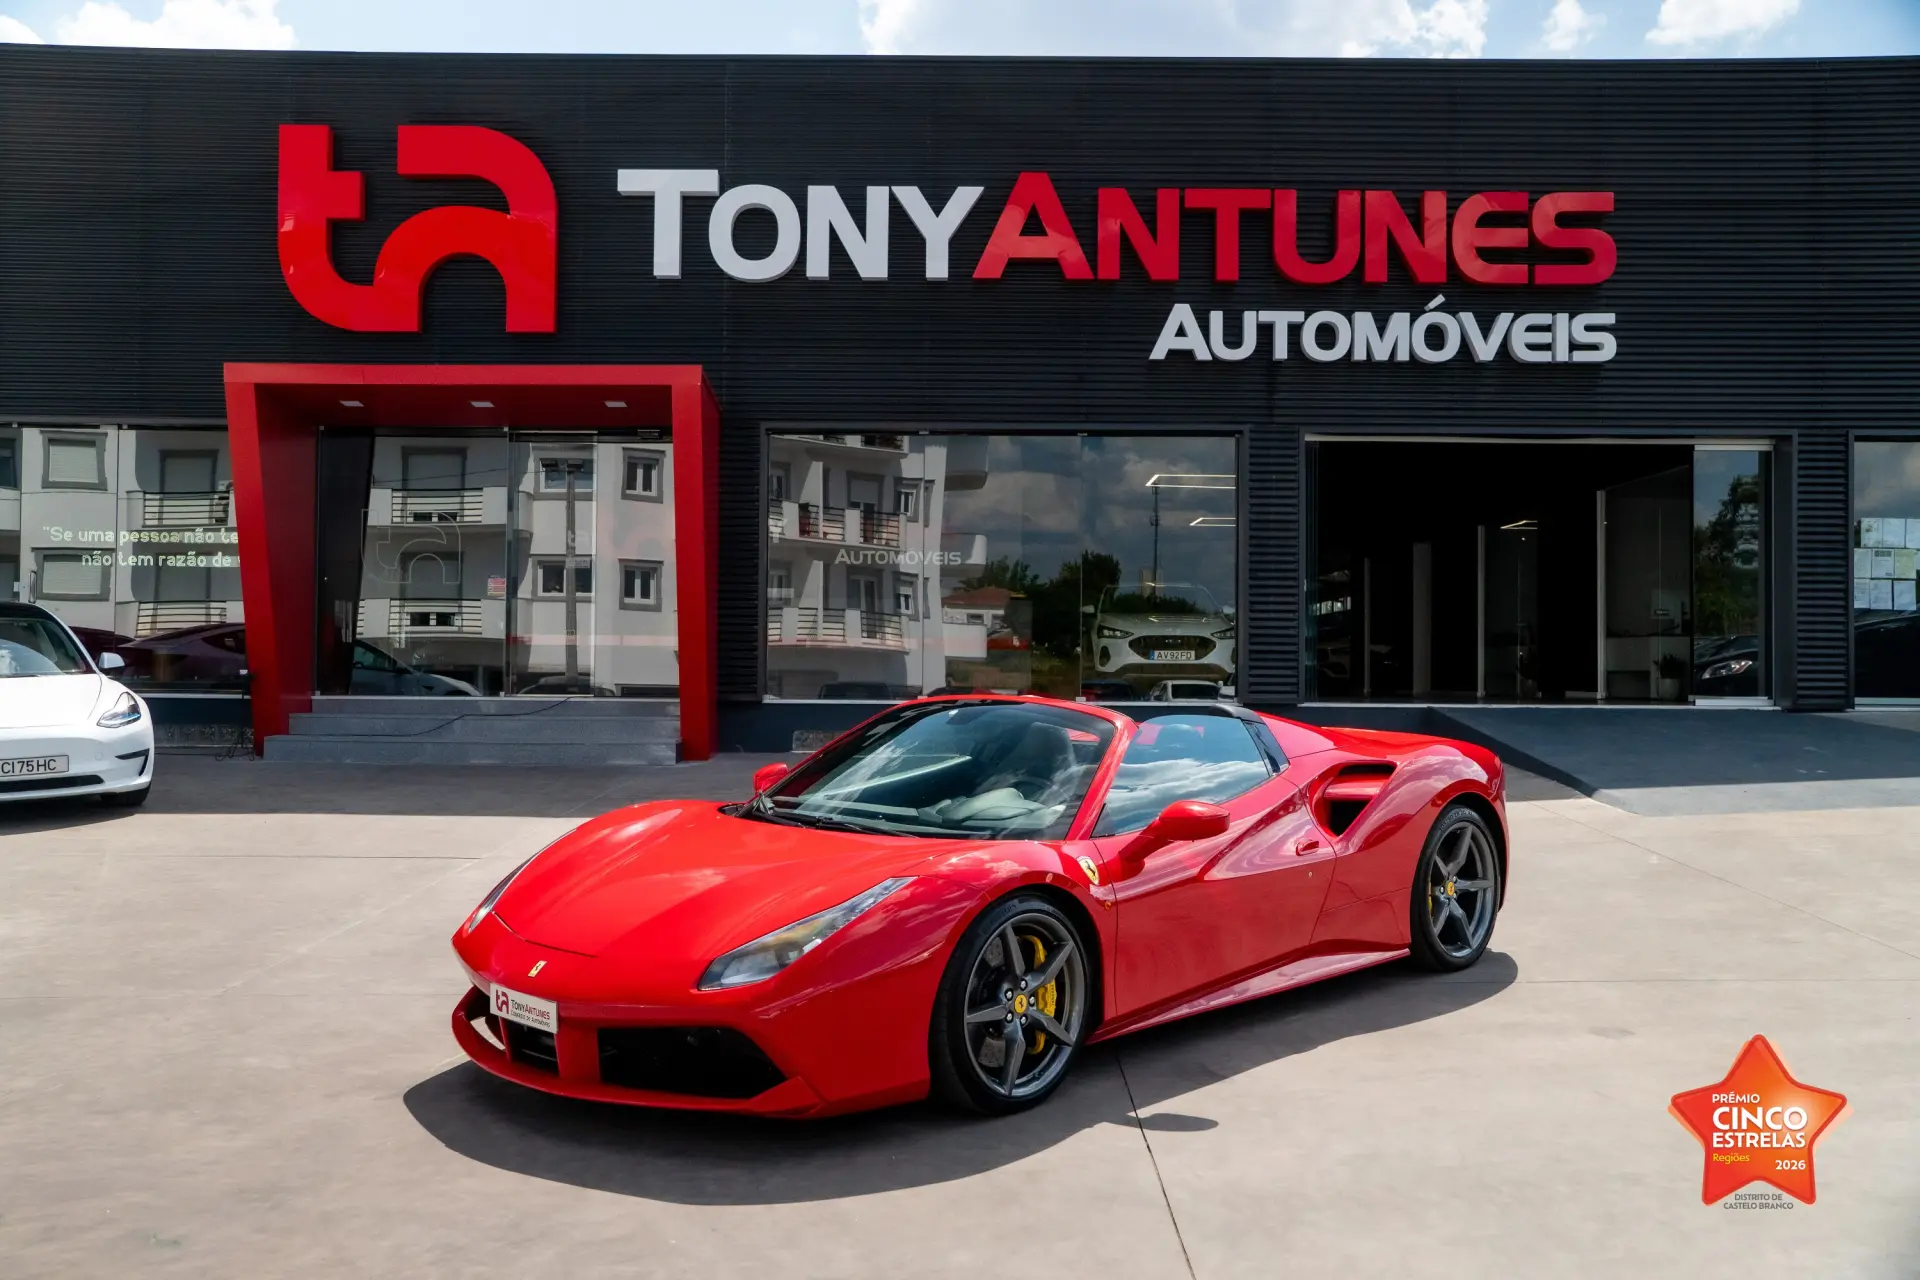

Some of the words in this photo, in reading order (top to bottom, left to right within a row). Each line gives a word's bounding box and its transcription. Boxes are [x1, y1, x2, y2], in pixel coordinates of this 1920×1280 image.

[1149, 294, 1618, 363] AUTOMÓVEIS
[78, 530, 115, 542] uma
[119, 530, 180, 545] pessoa
[184, 528, 215, 543] não
[82, 550, 112, 566] não
[117, 552, 154, 566] tem
[158, 550, 207, 567] razão
[212, 551, 232, 567] de
[834, 548, 962, 566] AUTOMÓVEIS
